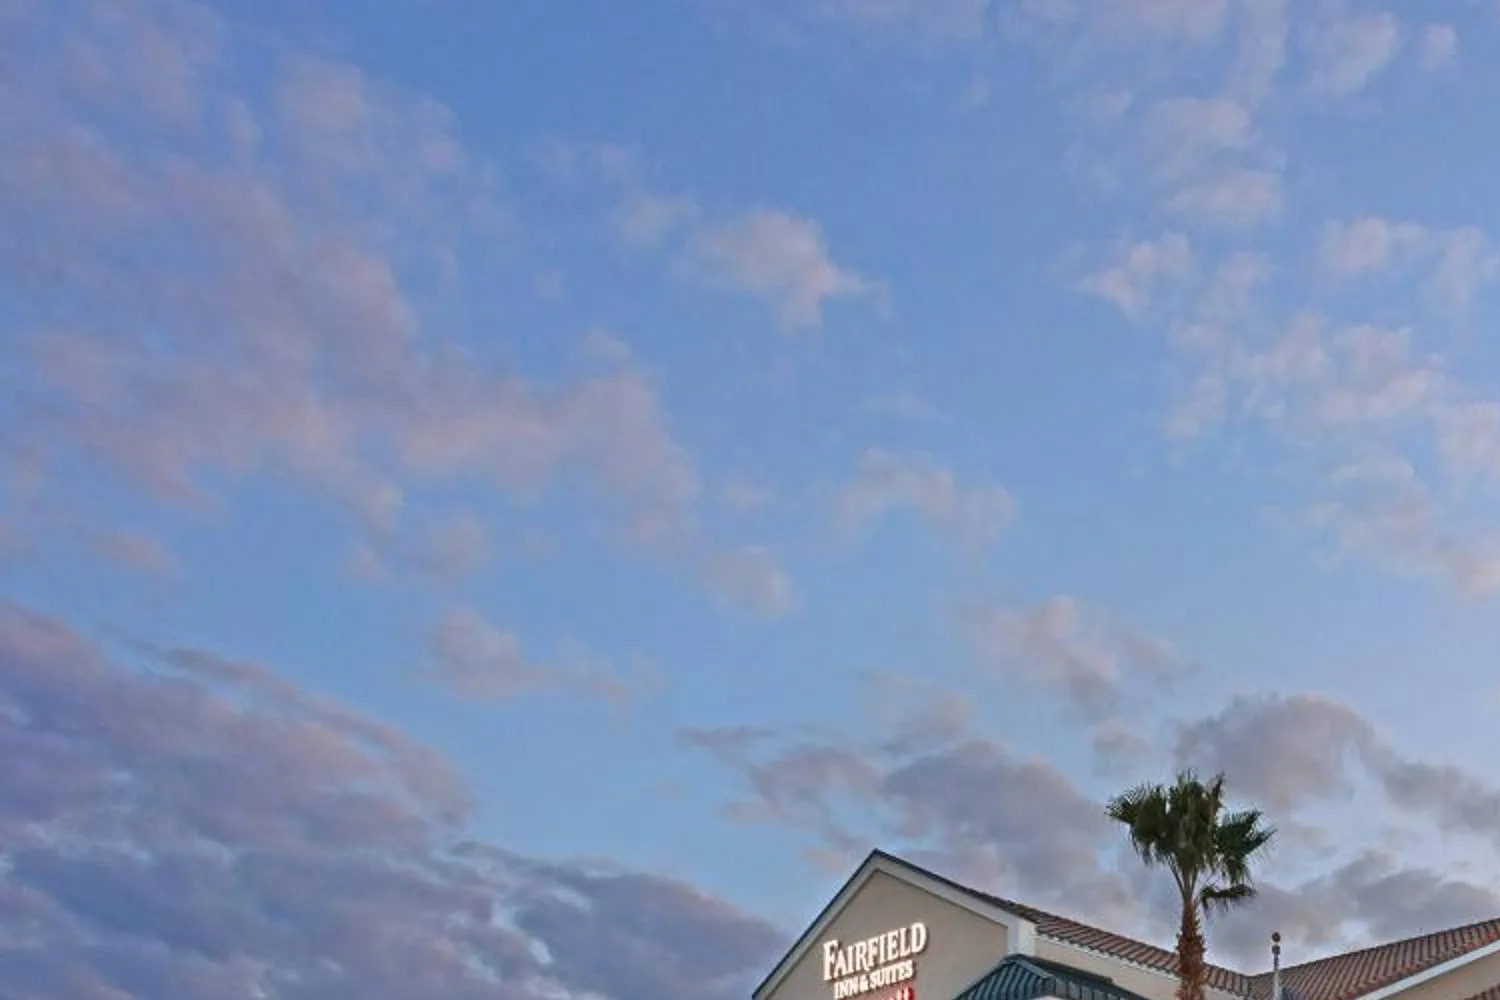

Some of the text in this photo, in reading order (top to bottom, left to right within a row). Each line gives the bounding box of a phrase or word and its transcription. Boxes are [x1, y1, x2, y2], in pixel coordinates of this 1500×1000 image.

[823, 922, 928, 981] FAIRFIELD
[834, 959, 914, 1000] INN & SUITES
